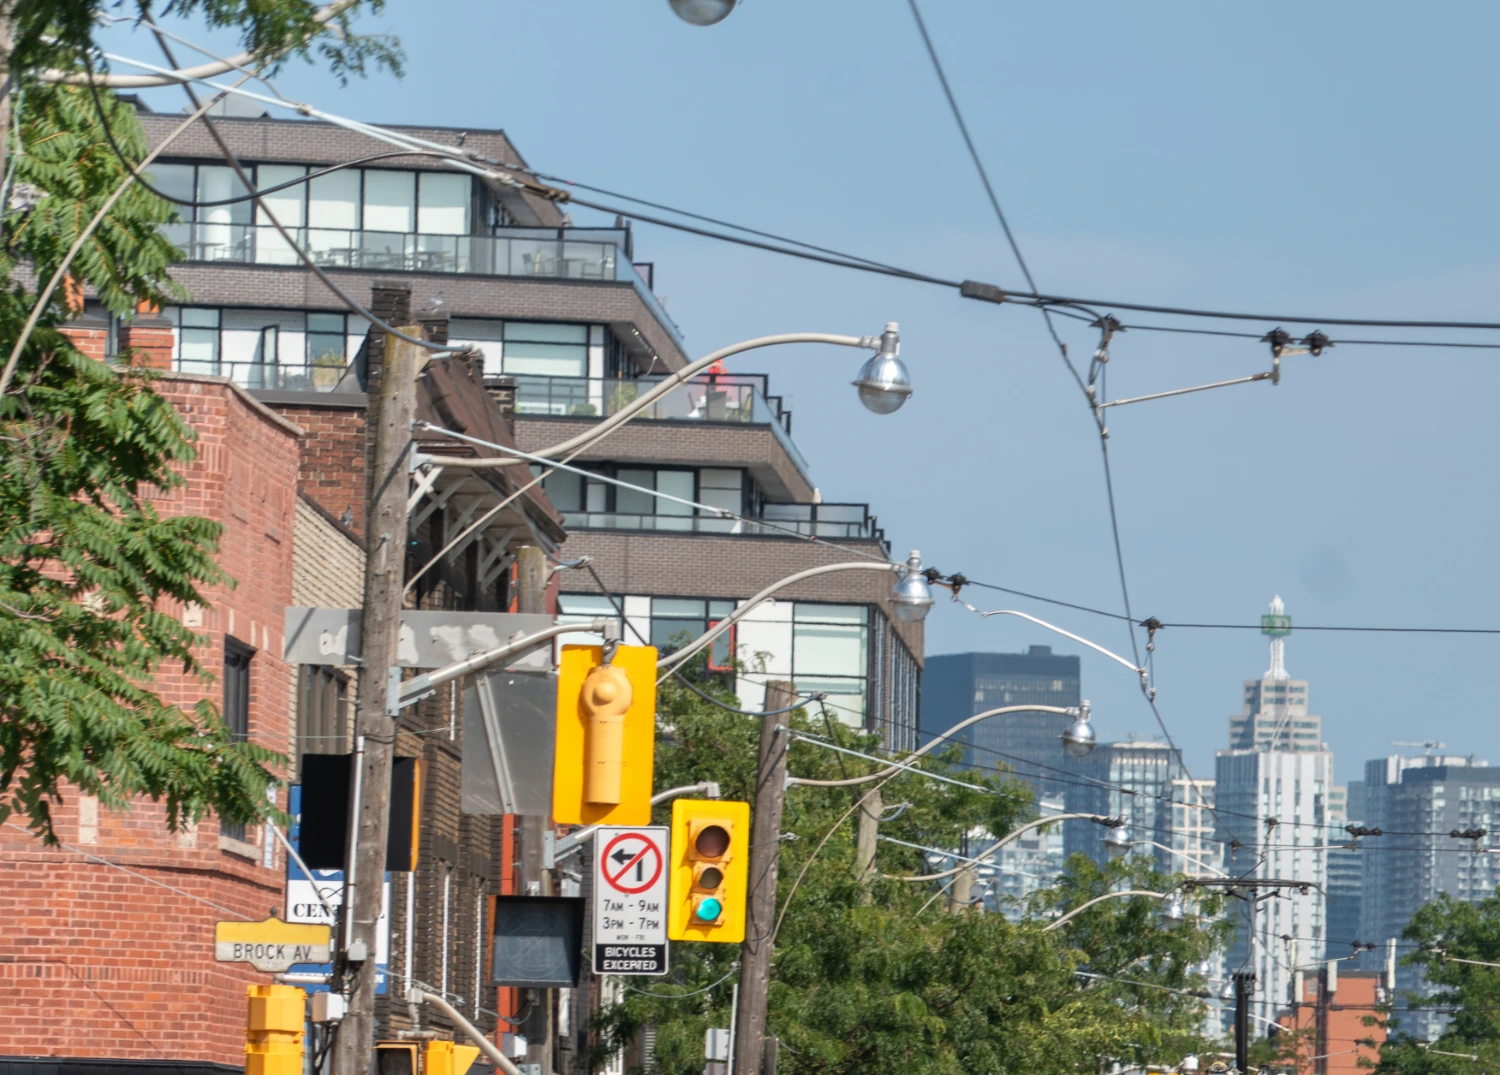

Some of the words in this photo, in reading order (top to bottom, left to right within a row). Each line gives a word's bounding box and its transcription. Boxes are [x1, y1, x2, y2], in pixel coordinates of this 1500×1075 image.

[603, 899, 624, 912] 7AM
[638, 899, 660, 913] 9AM
[602, 916, 624, 930] 3PM
[638, 917, 660, 930] 7PM
[233, 943, 286, 960] BROCK
[293, 945, 312, 961] AV
[604, 946, 657, 958] BICYCLES
[602, 960, 658, 971] EXCEPTED
